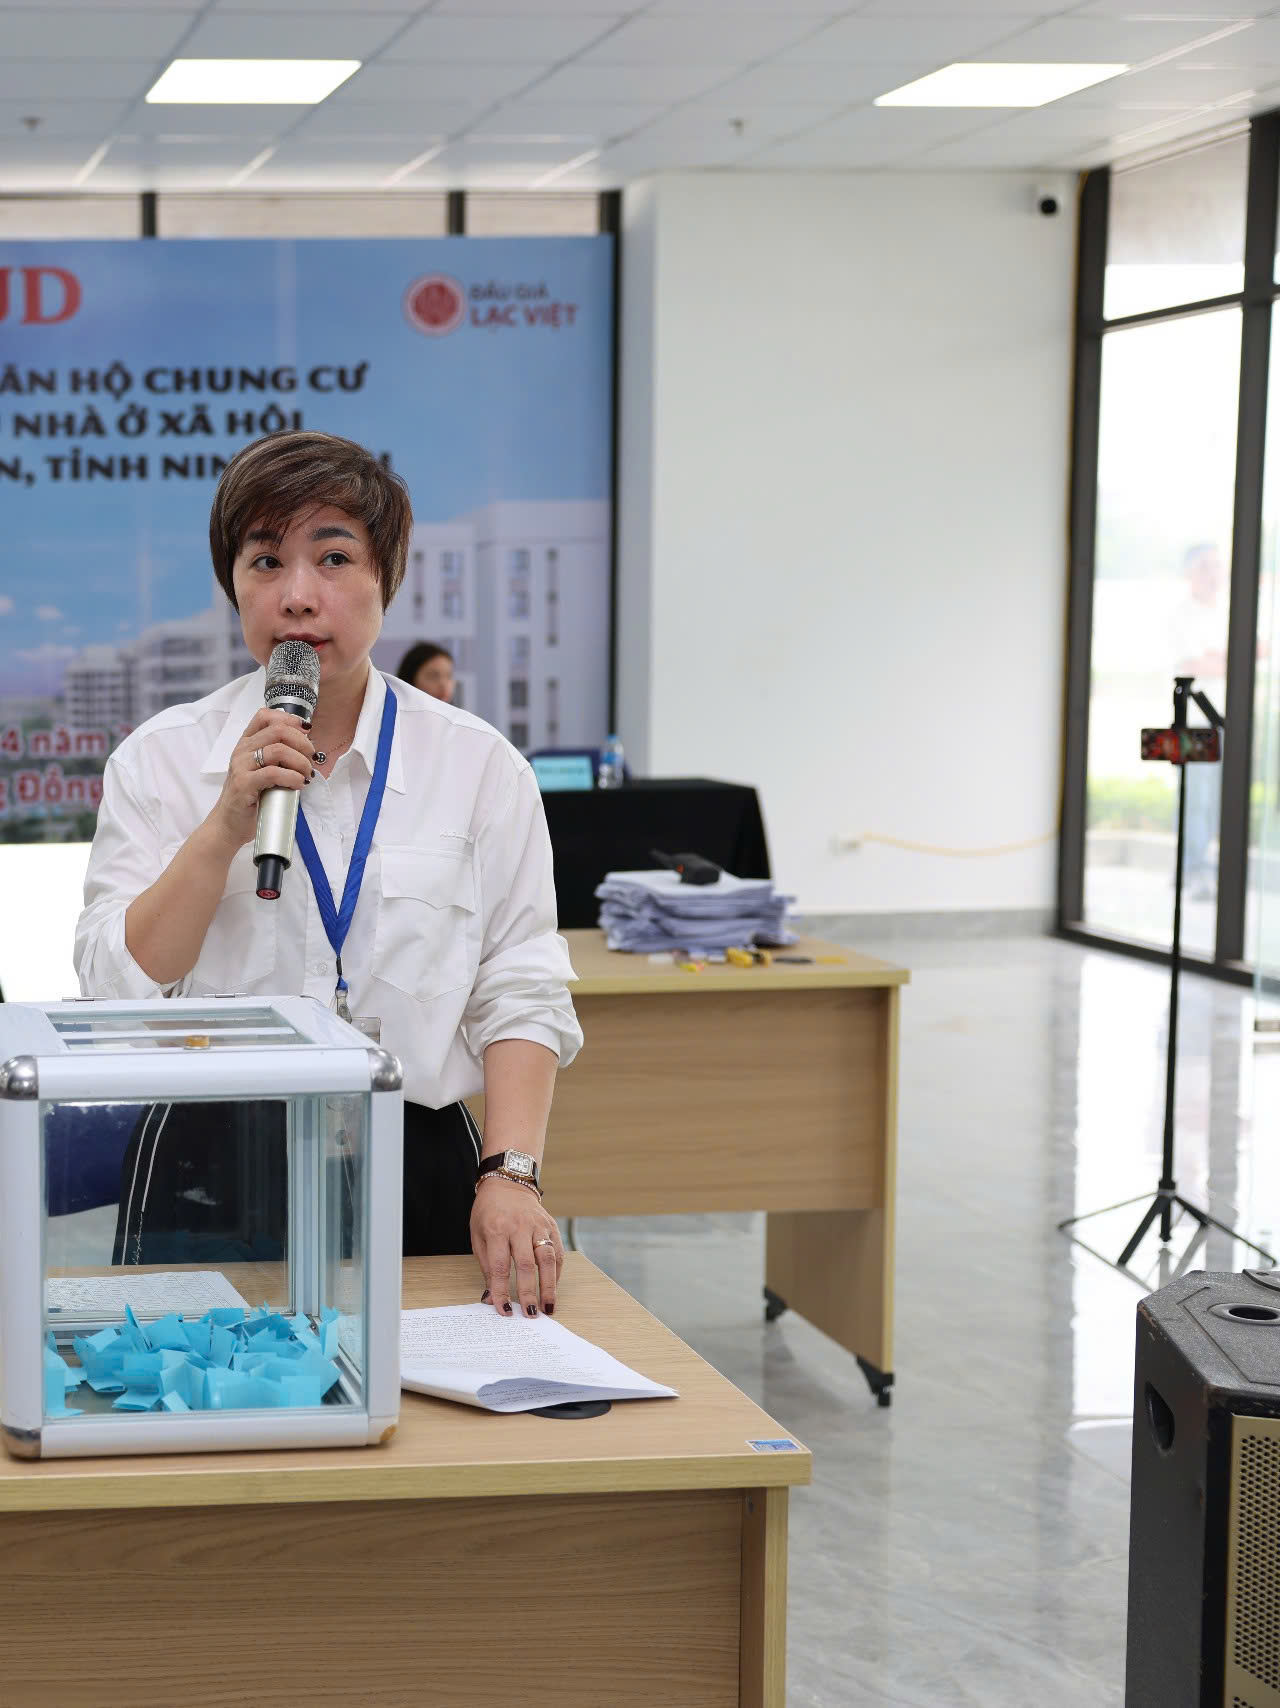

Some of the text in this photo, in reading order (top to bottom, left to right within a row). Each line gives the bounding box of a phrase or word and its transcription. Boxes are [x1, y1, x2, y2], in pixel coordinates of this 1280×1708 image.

[69, 360, 133, 400] HỘ
[145, 366, 297, 394] CHUNG
[308, 362, 369, 394] CƯ
[13, 403, 106, 439] NHÀ
[116, 403, 148, 438] Ở
[158, 402, 214, 437] XÃ
[47, 447, 148, 481] TỈNH
